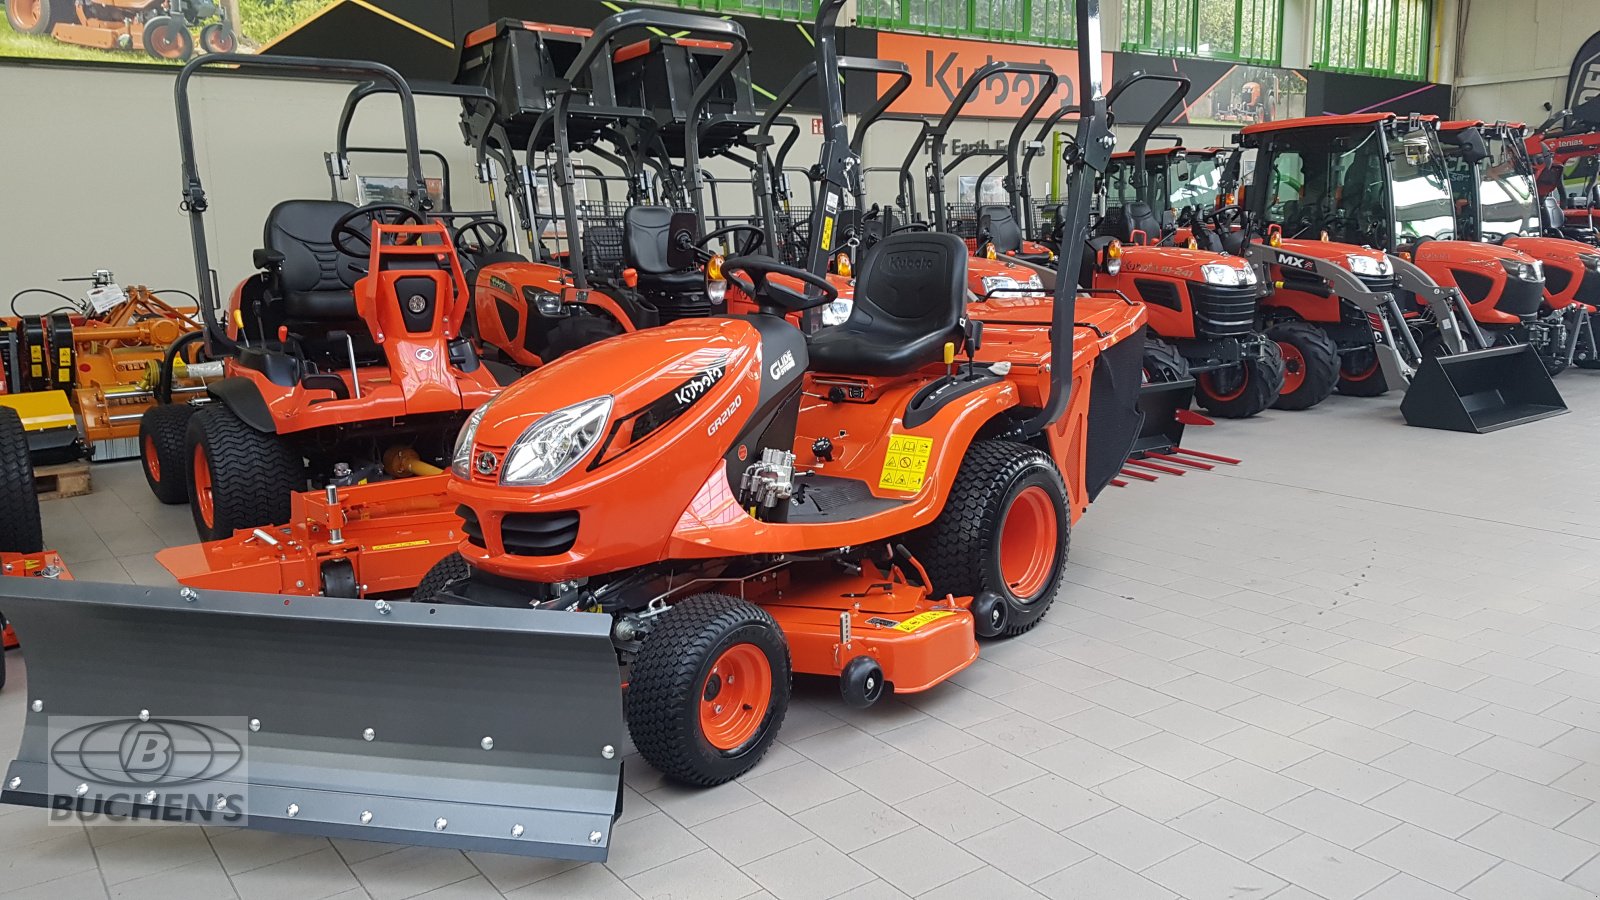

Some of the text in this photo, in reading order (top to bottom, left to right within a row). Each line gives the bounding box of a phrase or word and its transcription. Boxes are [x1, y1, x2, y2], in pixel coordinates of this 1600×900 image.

[1278, 253, 1304, 268] MX
[674, 366, 723, 405] Kubota
[707, 394, 742, 437] GR2120
